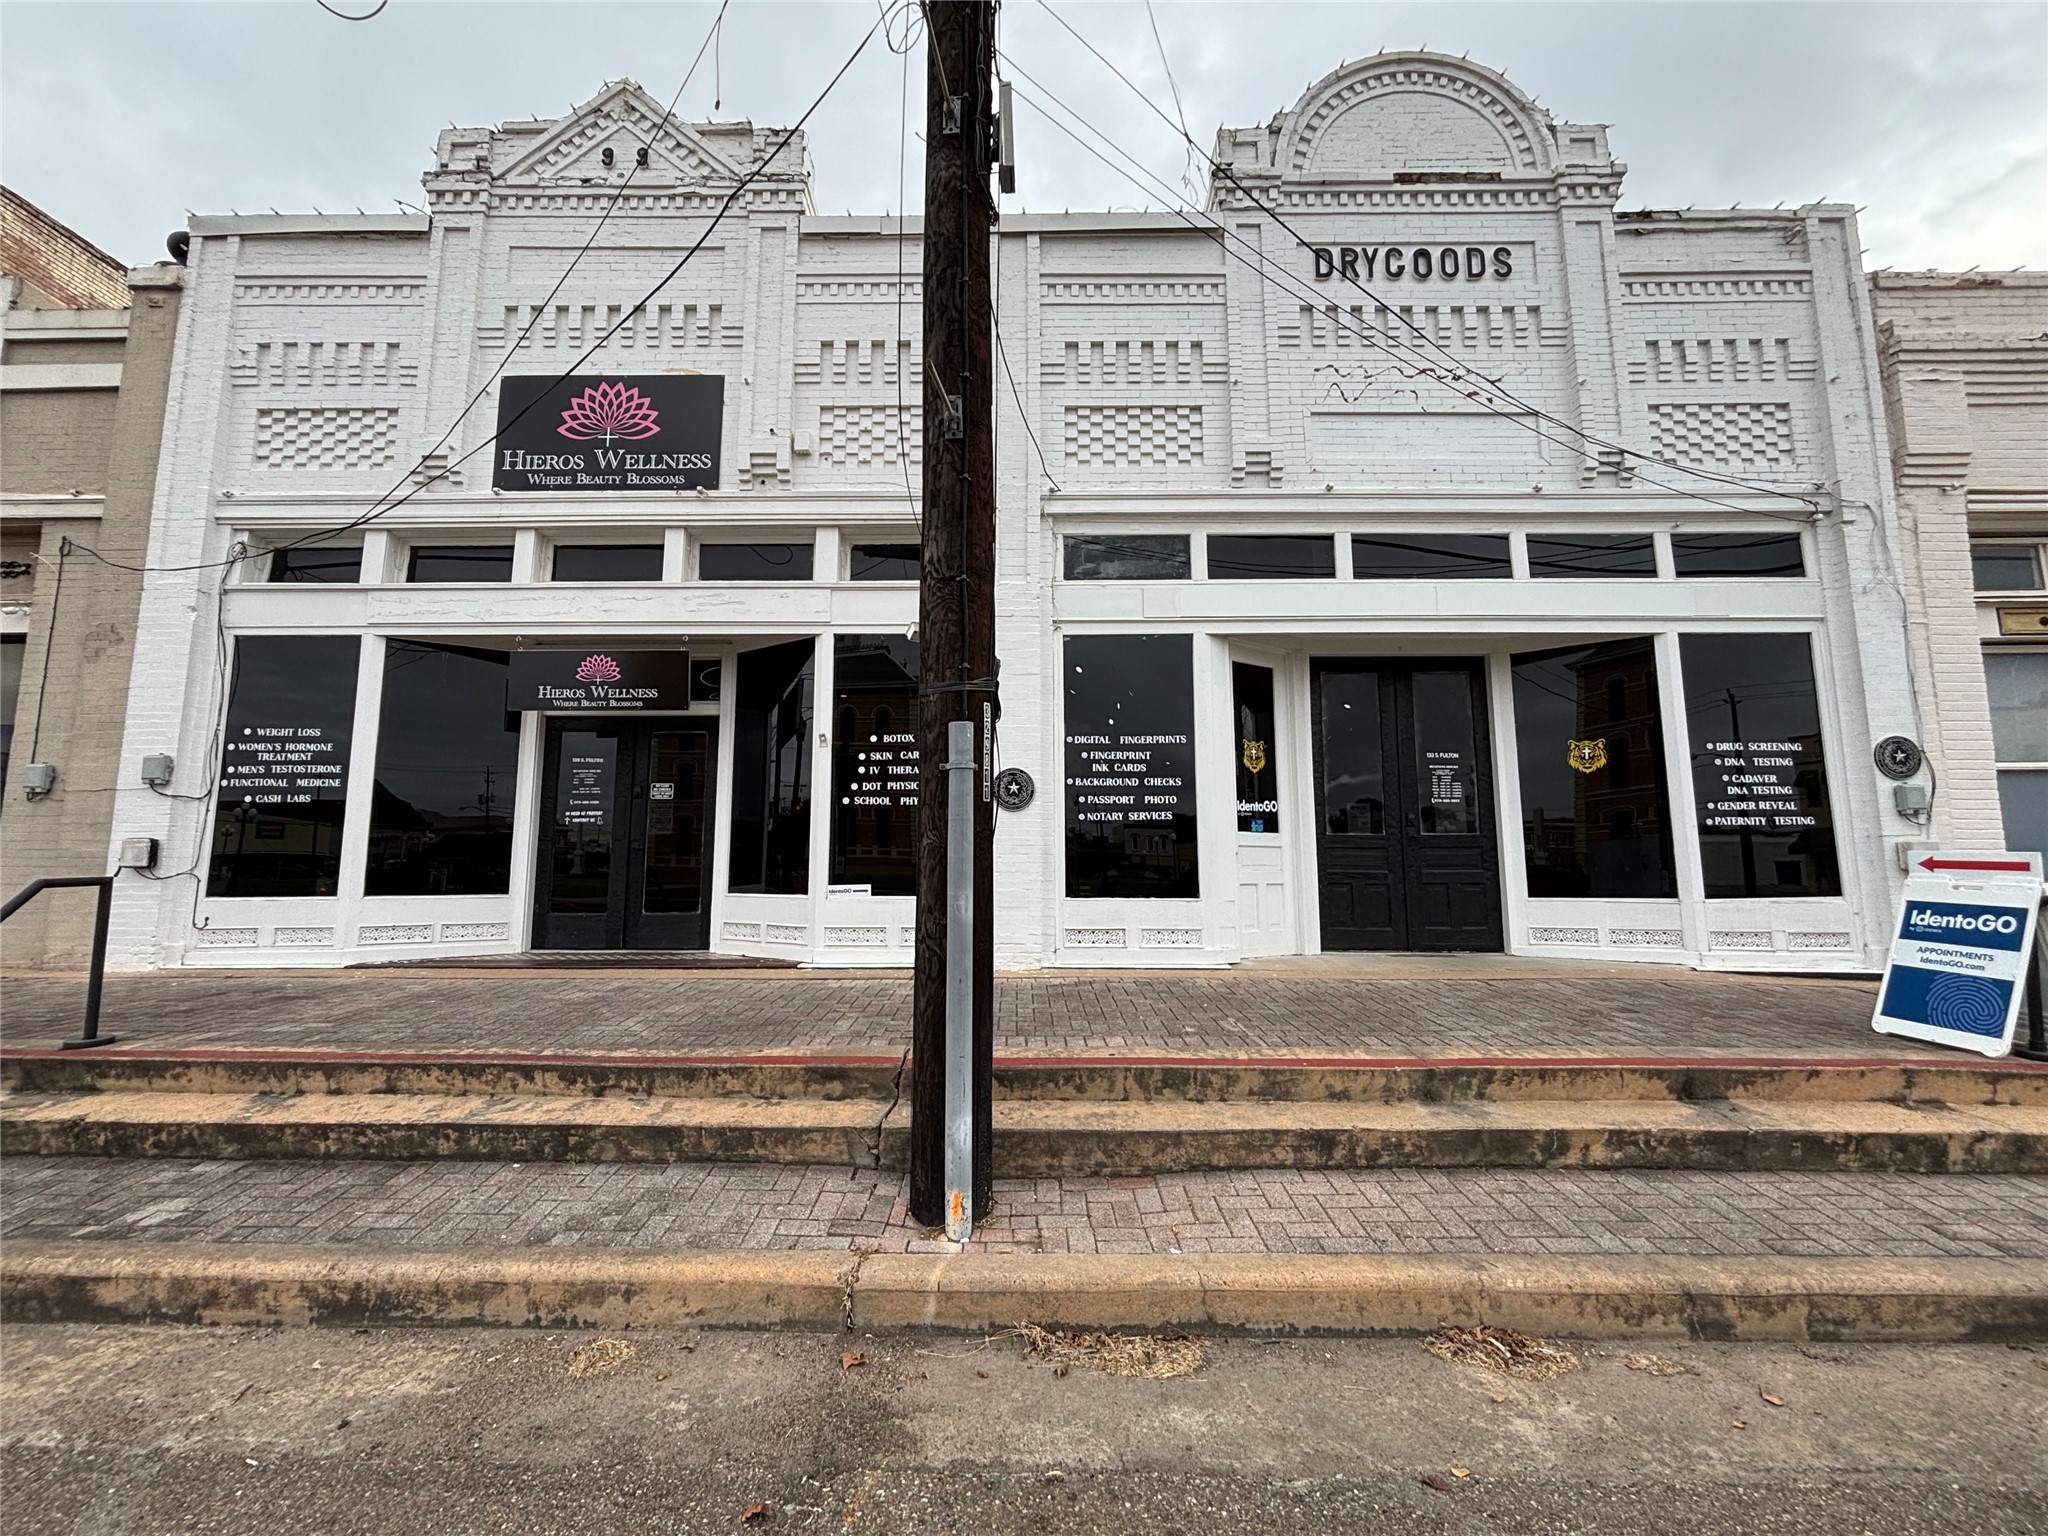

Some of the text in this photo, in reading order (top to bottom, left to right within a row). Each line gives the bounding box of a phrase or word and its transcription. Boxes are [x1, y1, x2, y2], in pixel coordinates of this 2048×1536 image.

[502, 448, 712, 470] HIEROS WELLNESS
[576, 473, 621, 485] BEAUTY
[626, 473, 685, 484] BLOSSOMS
[538, 686, 658, 699] HIEROS WELLNESS
[257, 728, 322, 737] WEIGHT LOSS
[883, 734, 915, 743] BOTOX
[1074, 735, 1187, 745] DIGITAL FINGERPRINTS
[238, 743, 334, 752] WOMEN'S HORMONE
[1716, 742, 1802, 751] DRUG SCREENING
[257, 753, 313, 761] TREATMENT
[870, 751, 920, 761] SKIN CAR
[1090, 751, 1151, 761] FINGERPRINT
[1724, 757, 1793, 767] DNA TESTING
[237, 765, 342, 774] MEN'S TESTOSTERONE
[869, 765, 919, 775] IV THERA
[1092, 763, 1147, 773] INK CARDS
[230, 779, 342, 787] FUNCTIONAL MEDICINE
[1075, 777, 1182, 787] BACKGROUND CHECKS
[1732, 774, 1778, 784] CADAVER
[862, 782, 883, 791] DOT
[1727, 786, 1793, 795] DNA TESTING
[255, 794, 311, 803] CASH LABS
[854, 796, 919, 806] SCHOOL PHY
[1087, 795, 1178, 805] PASSPORT PHOTO
[1237, 799, 1278, 813] IdentoGO
[1717, 801, 1798, 810] GENDER REVEAL
[1087, 812, 1173, 821] NOTARY SERVICES
[1715, 816, 1815, 826] PATERNITY TESTING
[1910, 909, 2017, 933] IdentoGO
[1916, 946, 1994, 962] APPOINTMENTS
[1919, 956, 1985, 972] IdentoGO.com
